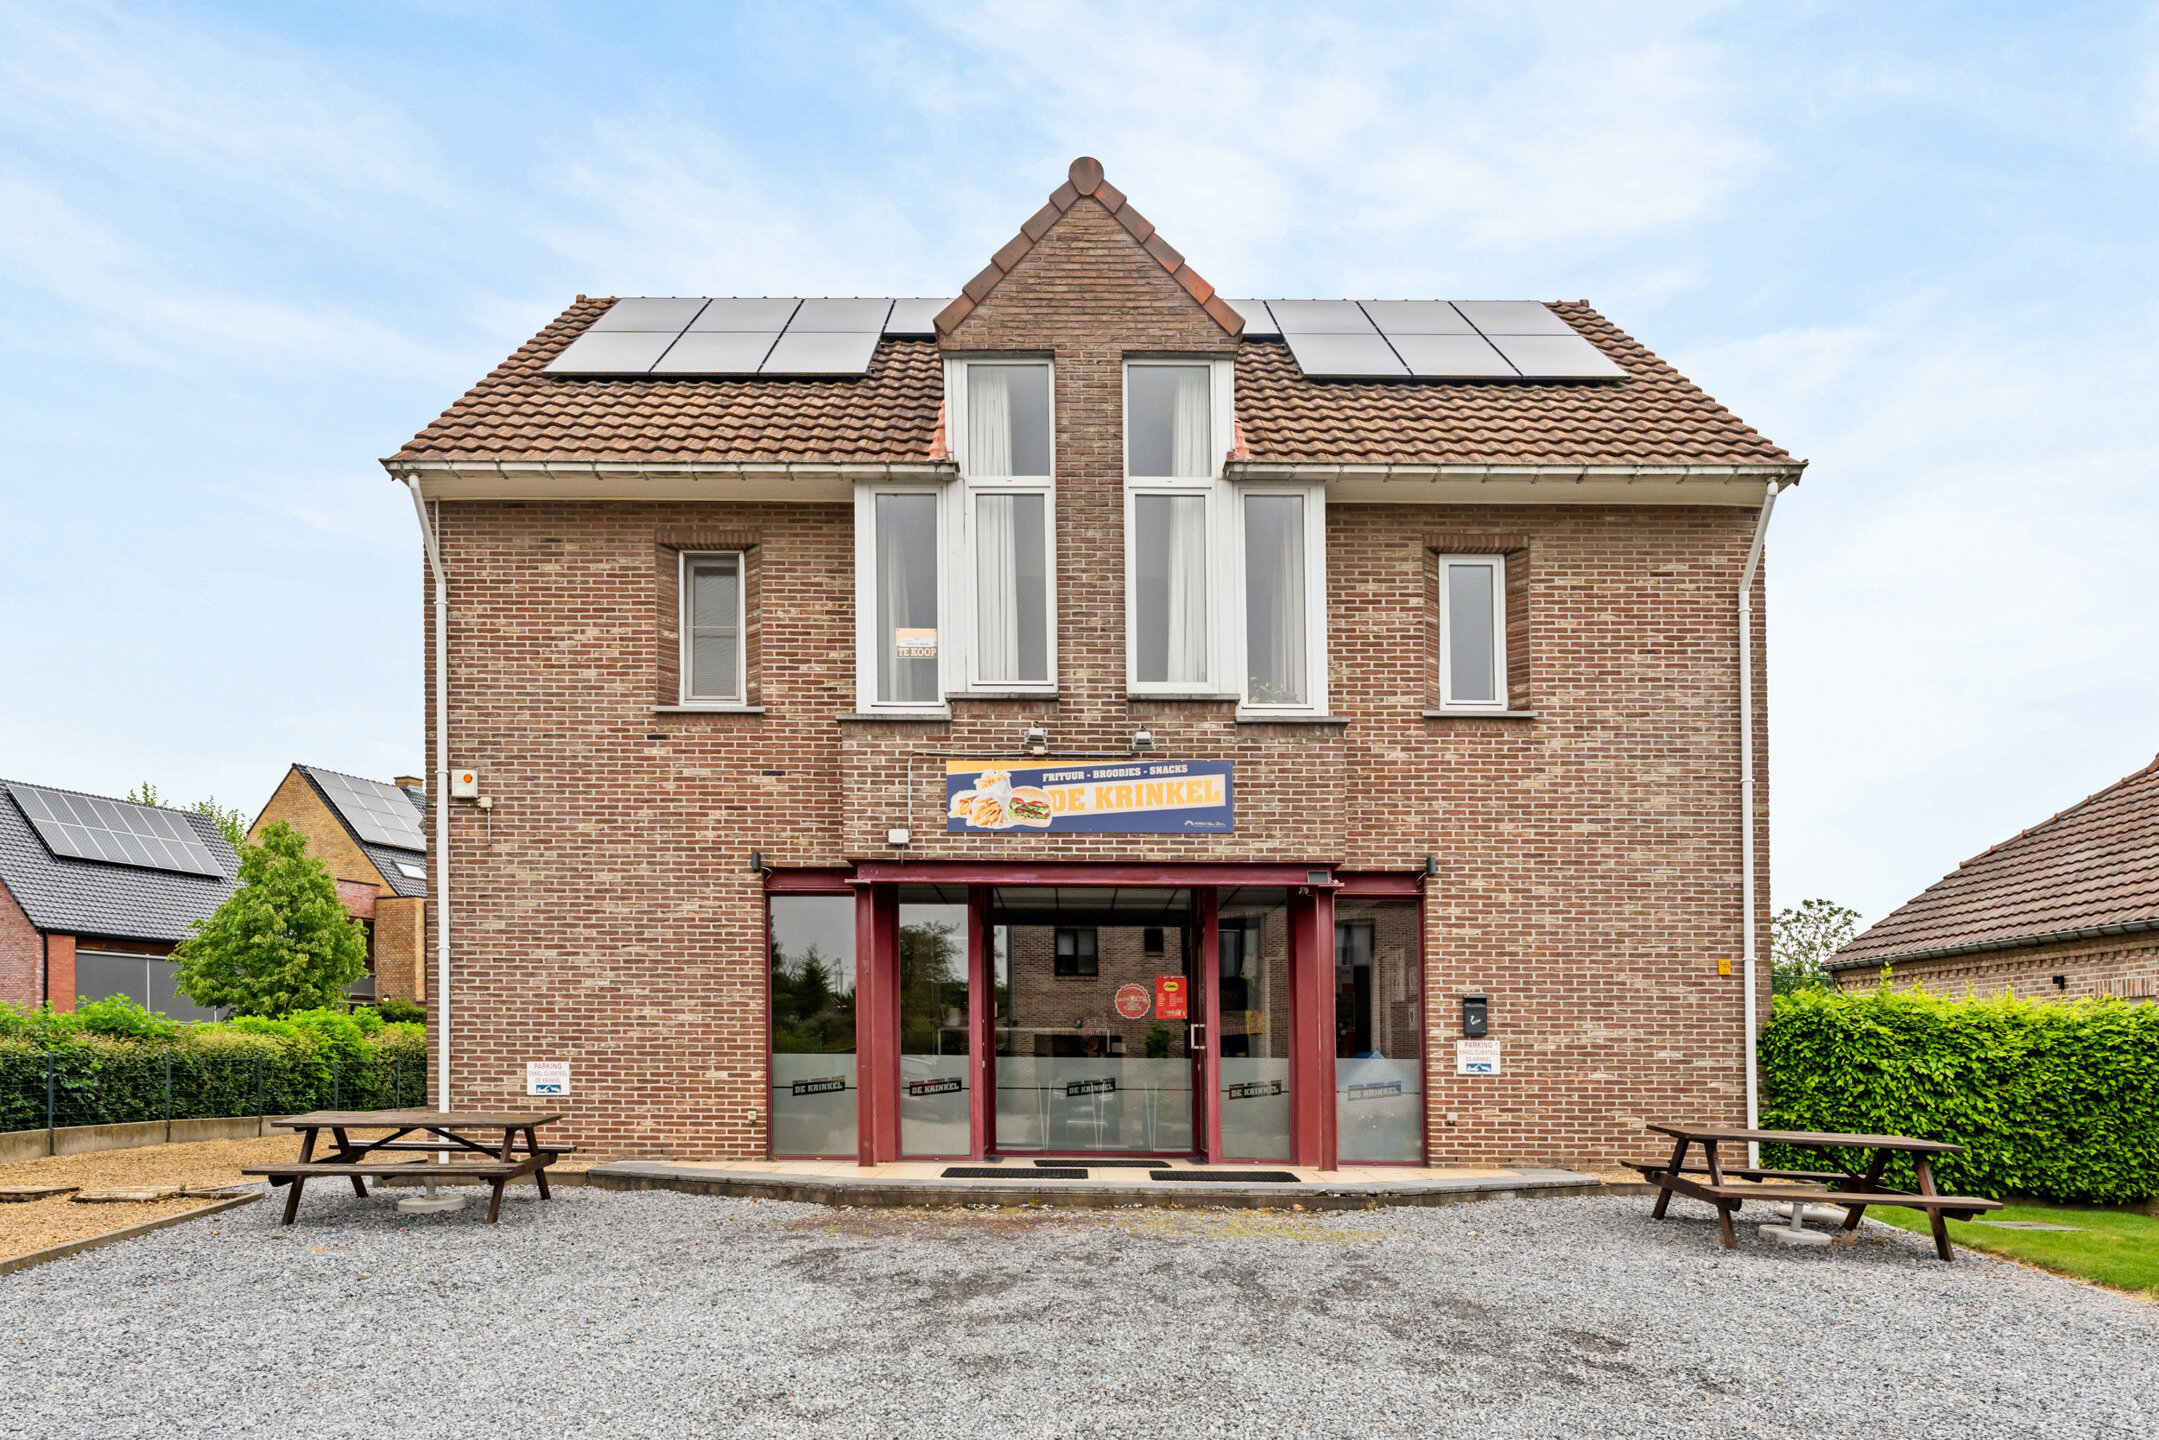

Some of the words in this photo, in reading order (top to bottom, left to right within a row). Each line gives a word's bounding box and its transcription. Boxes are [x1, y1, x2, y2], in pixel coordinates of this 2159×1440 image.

[897, 647, 910, 657] TE
[910, 647, 937, 657] KOOP
[1042, 771, 1085, 783] FRITUUR
[1092, 767, 1141, 779] BROODJES
[1149, 764, 1188, 776] SNACKS
[1049, 787, 1085, 812] DE
[1095, 779, 1221, 810] KRINKEL
[795, 1085, 806, 1093] DE
[807, 1082, 842, 1092] KRINKEL
[911, 1086, 923, 1094] DE
[924, 1082, 959, 1093] KRINKEL
[1069, 1086, 1079, 1094] DE
[1231, 1089, 1242, 1097] DE
